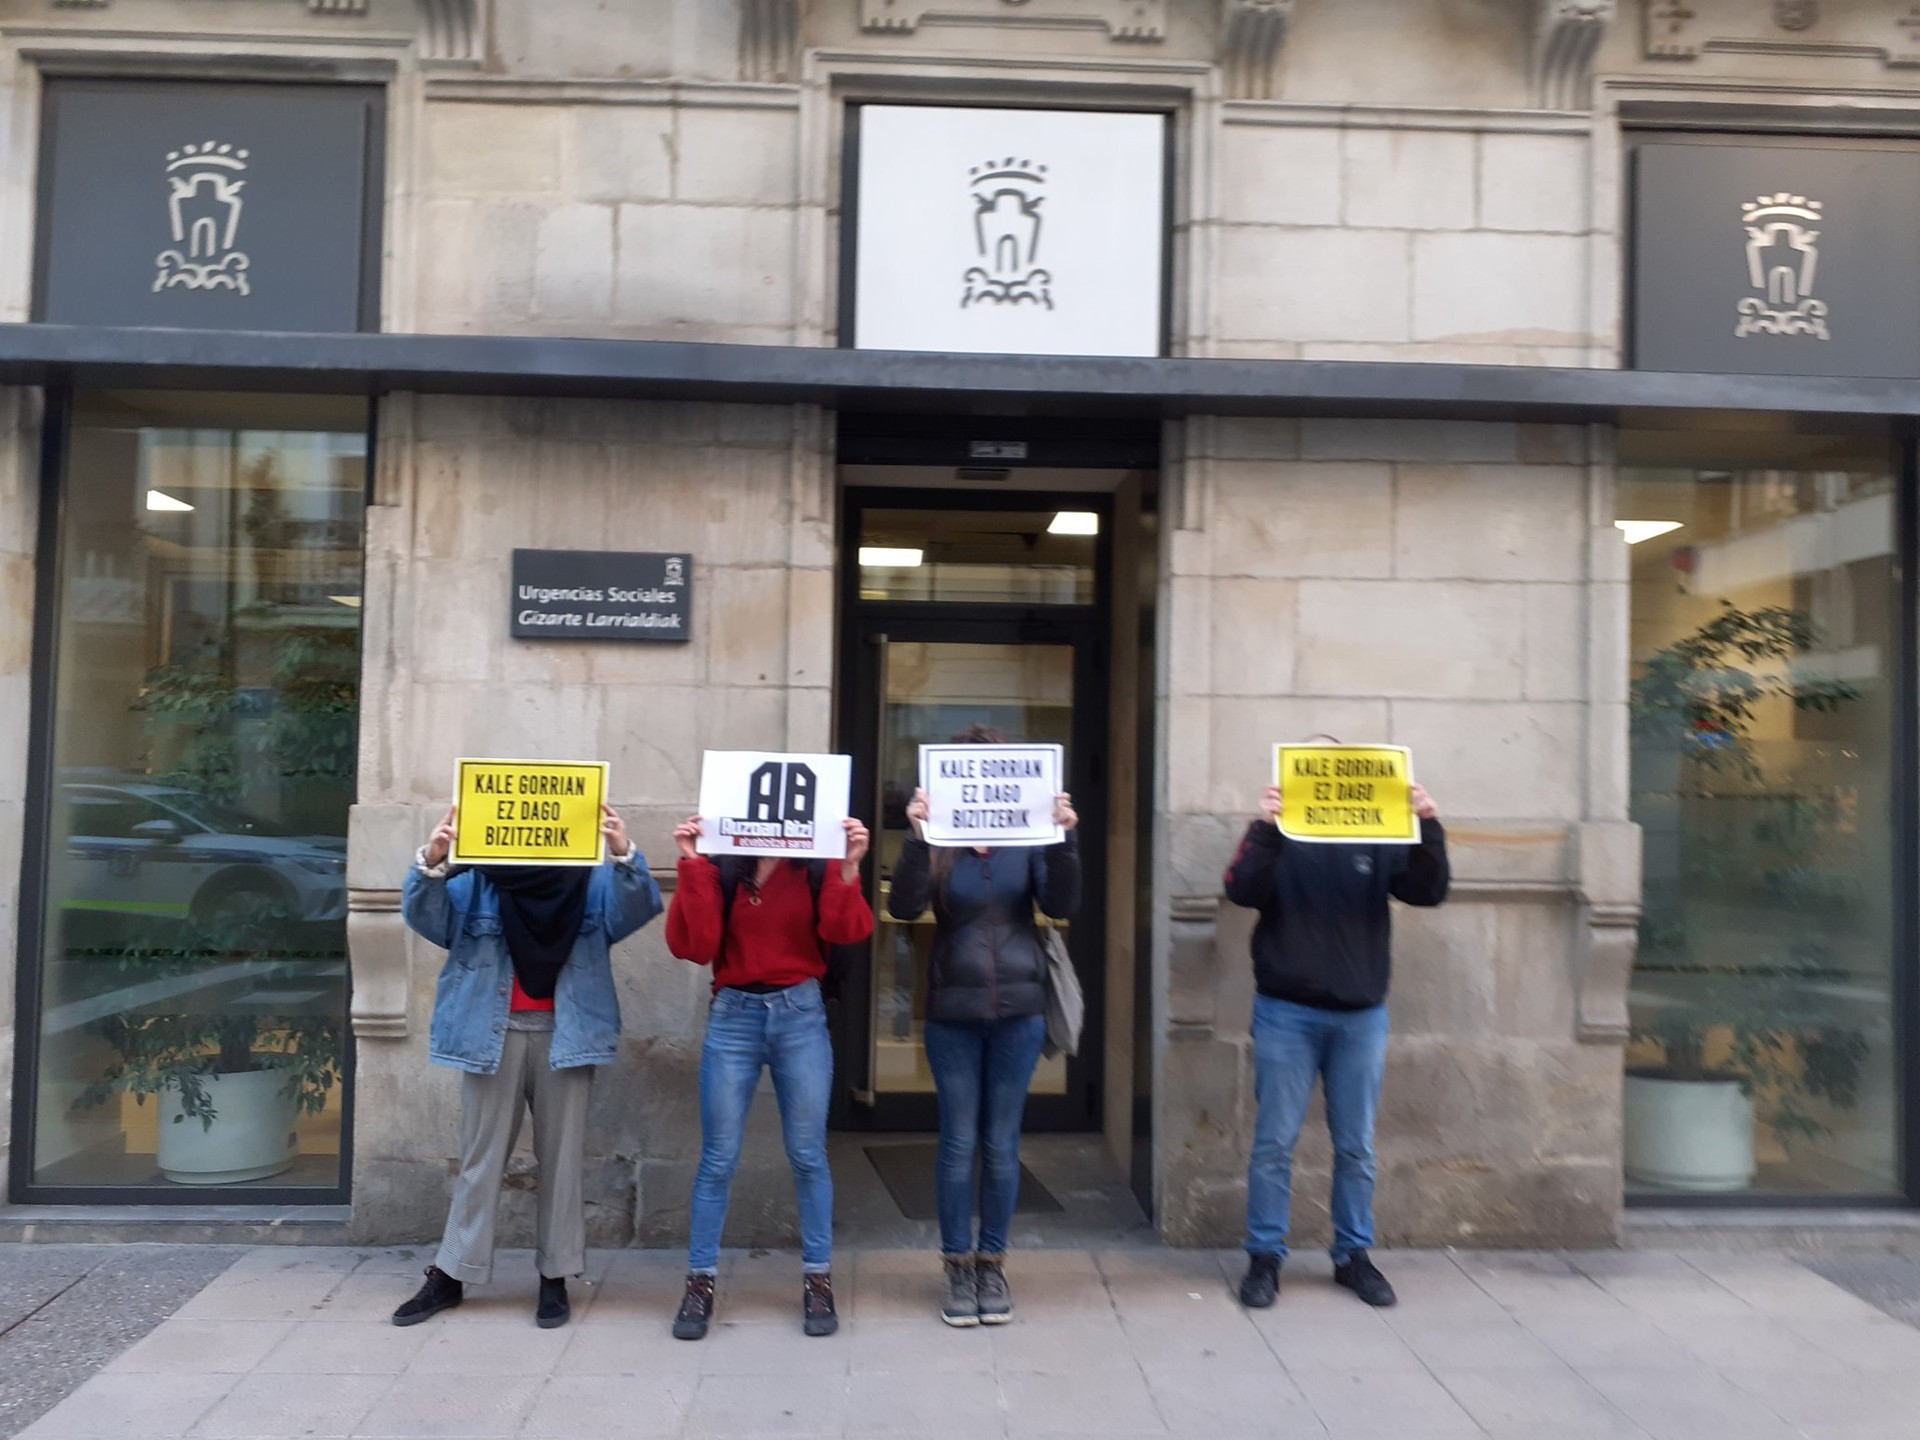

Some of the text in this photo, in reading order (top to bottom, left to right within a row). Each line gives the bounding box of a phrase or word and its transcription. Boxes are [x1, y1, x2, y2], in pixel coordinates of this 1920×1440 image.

[519, 585, 676, 603] Urgencias Sociales
[518, 609, 681, 628] Gizarte Larrialdiak
[940, 759, 1042, 778] KALE GORRIAN
[1293, 758, 1397, 778] KALE GORRIAN
[475, 774, 585, 796] KALE GORRIAN
[961, 784, 1021, 803] EZ DAGO
[1314, 782, 1375, 802] EZ DAGO
[497, 800, 561, 821] EZ DAGO
[951, 808, 1030, 828] BIZITZERIK
[1305, 805, 1384, 826] BIZITZERIK
[485, 826, 569, 847] BIZITZERIK
